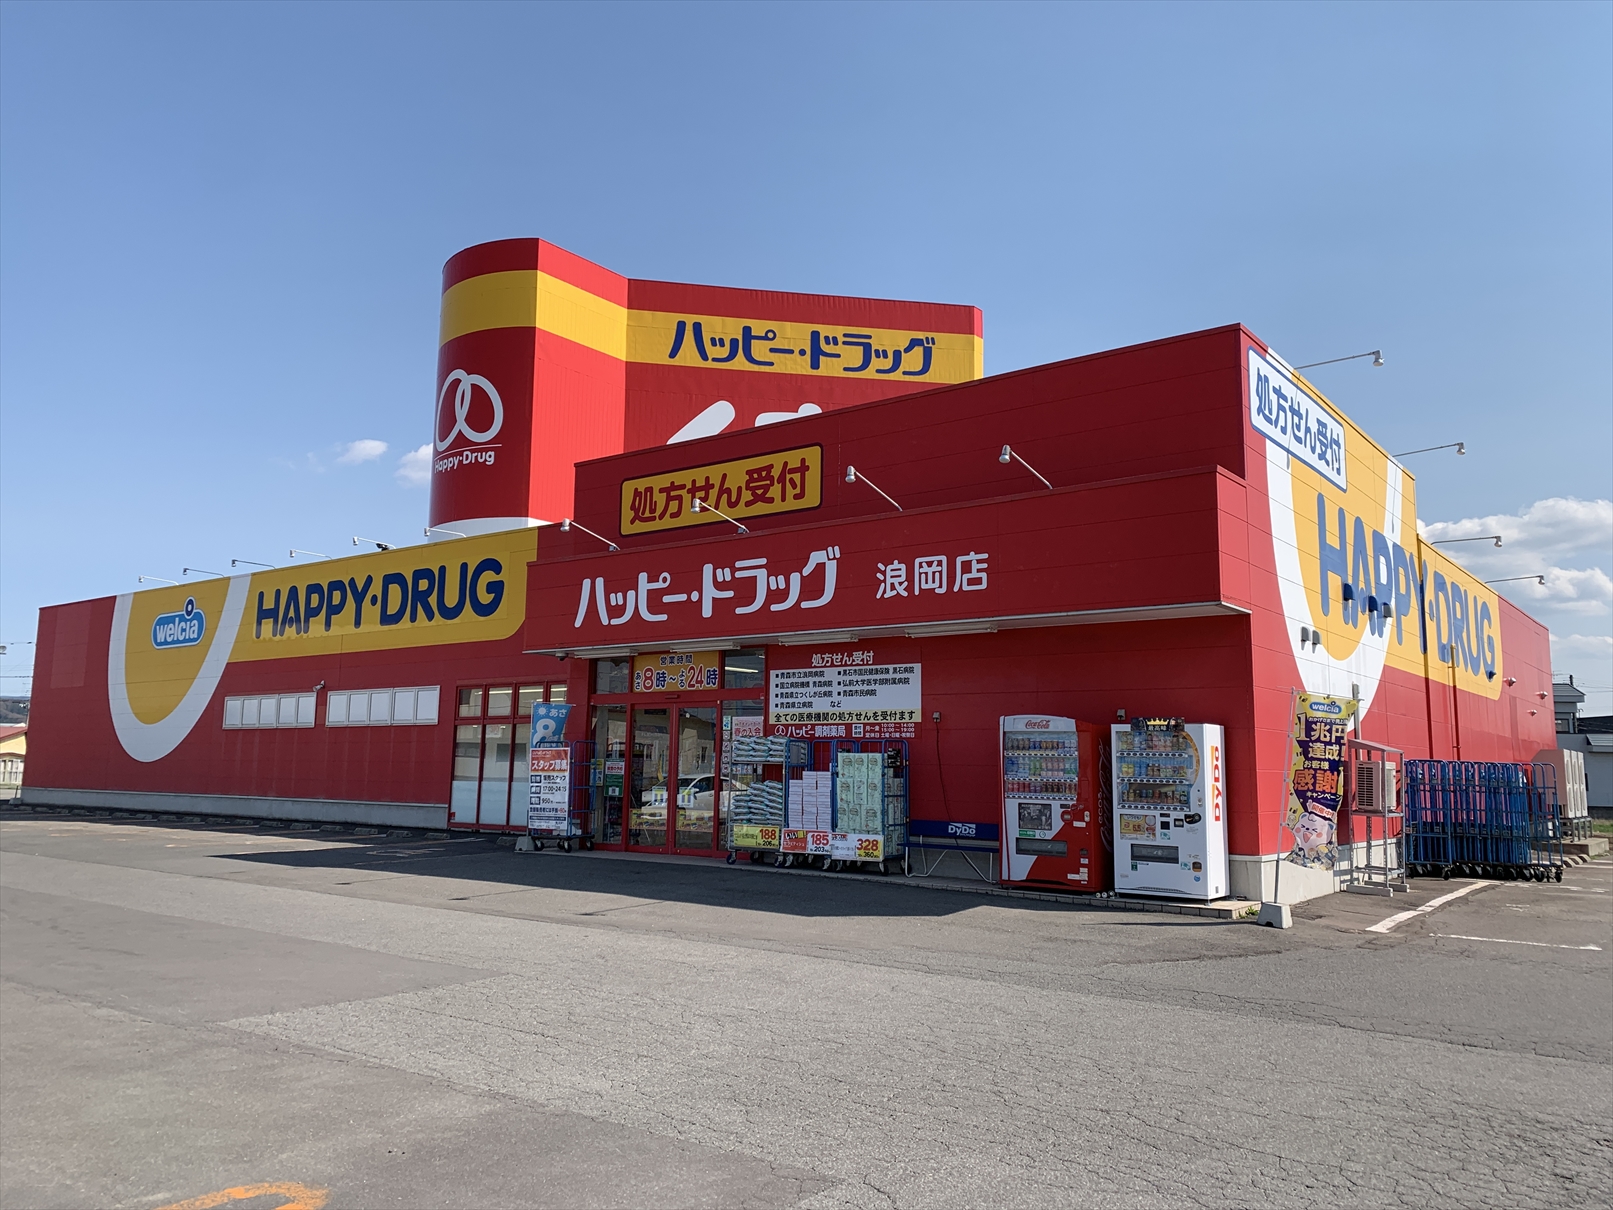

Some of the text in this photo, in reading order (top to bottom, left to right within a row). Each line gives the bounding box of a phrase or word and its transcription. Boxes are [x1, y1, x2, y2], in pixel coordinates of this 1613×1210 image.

[1255, 366, 1342, 476] 処方せん受付
[629, 457, 810, 526] 処方せん受付
[875, 552, 989, 600] 浪岡店
[155, 617, 199, 643] welcia
[660, 655, 693, 666] 営業時間
[811, 651, 874, 667] 処方せん受付
[780, 690, 833, 699] 青森県立つくしが丘病院
[842, 689, 877, 698] 青森市民病院
[780, 701, 814, 709] 青森県立病院
[830, 700, 842, 708] など
[1311, 702, 1339, 714] welcia
[549, 708, 567, 718] あさ
[774, 710, 916, 723] 全ての医療機関の処方せんを受付ます
[787, 725, 846, 737] ハッピー調剤薬局
[532, 759, 568, 771] スタッフ募集
[1294, 769, 1338, 793] 感謝
[759, 828, 776, 840] 188
[811, 833, 829, 846] 185
[856, 838, 879, 851] 328
